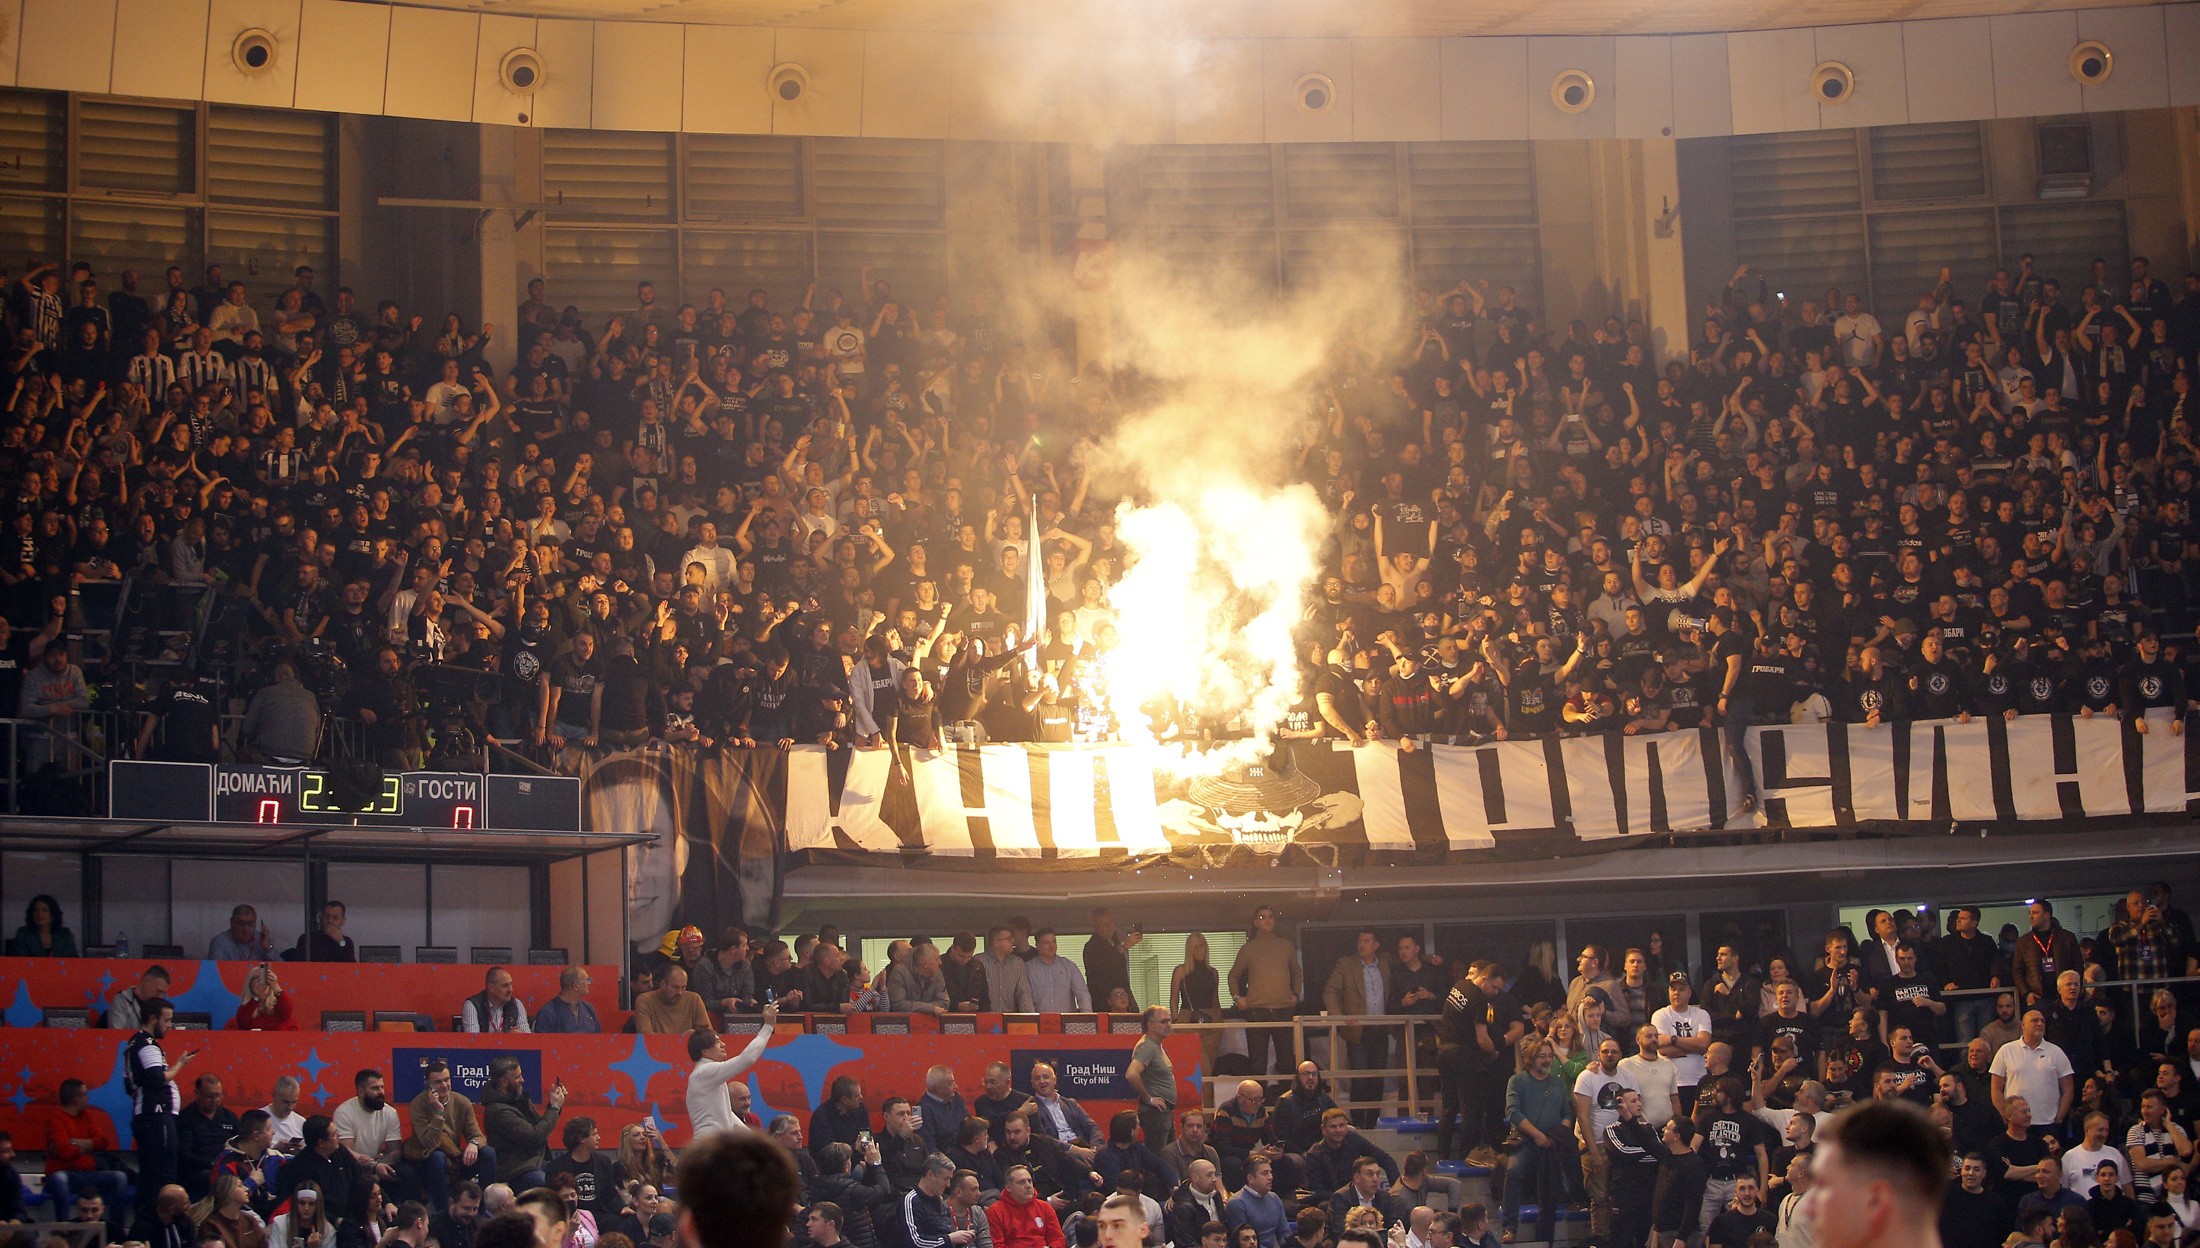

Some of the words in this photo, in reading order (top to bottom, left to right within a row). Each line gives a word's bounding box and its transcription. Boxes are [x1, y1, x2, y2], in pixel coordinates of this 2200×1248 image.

[1897, 539, 1923, 547] adidas
[1751, 665, 1785, 675] ГРОБАРИ
[217, 772, 292, 795] ДОМАЋИ
[418, 779, 476, 800] ГОСТИ
[1895, 986, 1928, 996] PARTIZAN
[456, 1064, 484, 1078] Град
[1066, 1064, 1091, 1077] Град
[1092, 1064, 1116, 1074] Ниш
[463, 1078, 480, 1089] City
[1073, 1076, 1088, 1086] City
[1089, 1076, 1097, 1084] of
[1098, 1076, 1110, 1084] Niš
[1712, 1120, 1740, 1133] GHETTO
[1709, 1130, 1741, 1143] BLASTER
